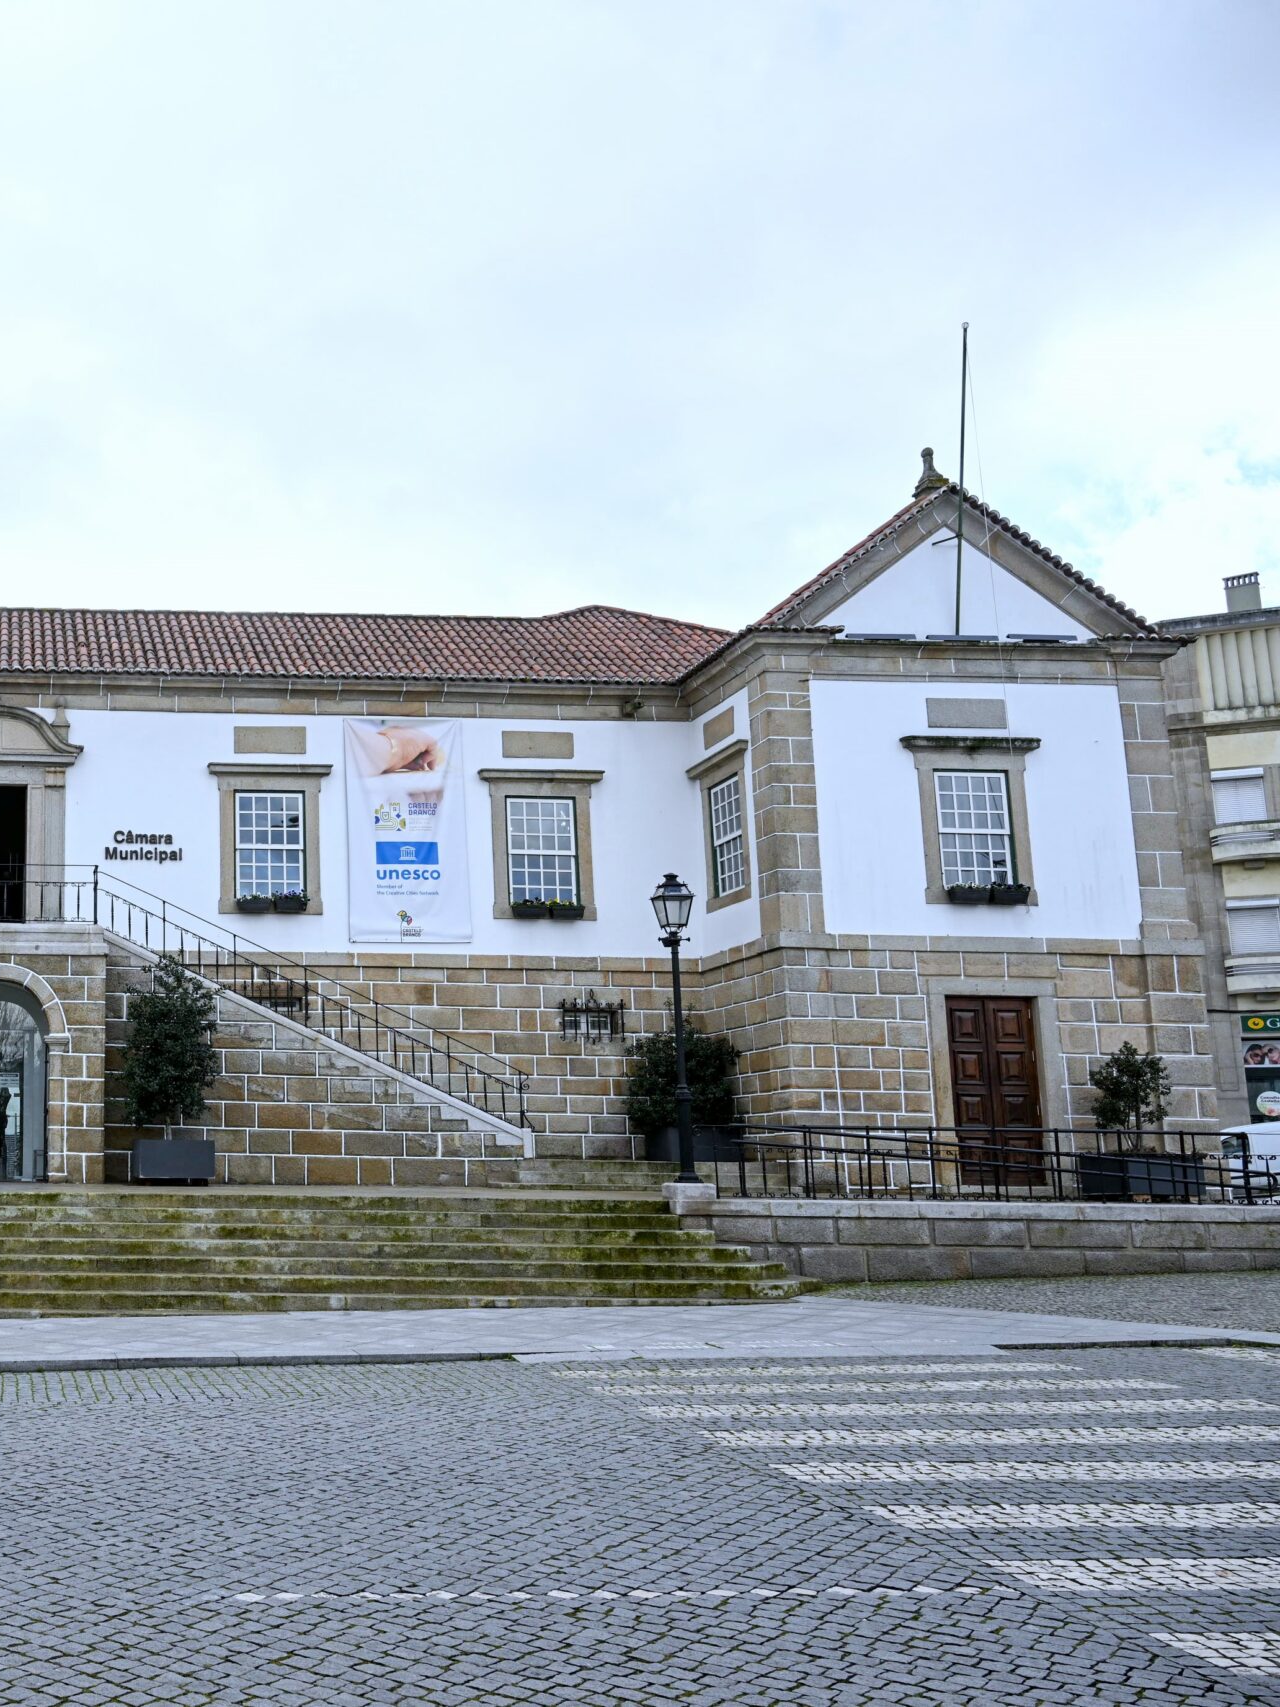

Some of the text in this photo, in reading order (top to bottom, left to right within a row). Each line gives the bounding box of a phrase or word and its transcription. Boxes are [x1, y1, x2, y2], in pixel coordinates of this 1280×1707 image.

[113, 830, 173, 845] Câmara
[105, 847, 182, 864] Municipal
[377, 869, 440, 880] unesco
